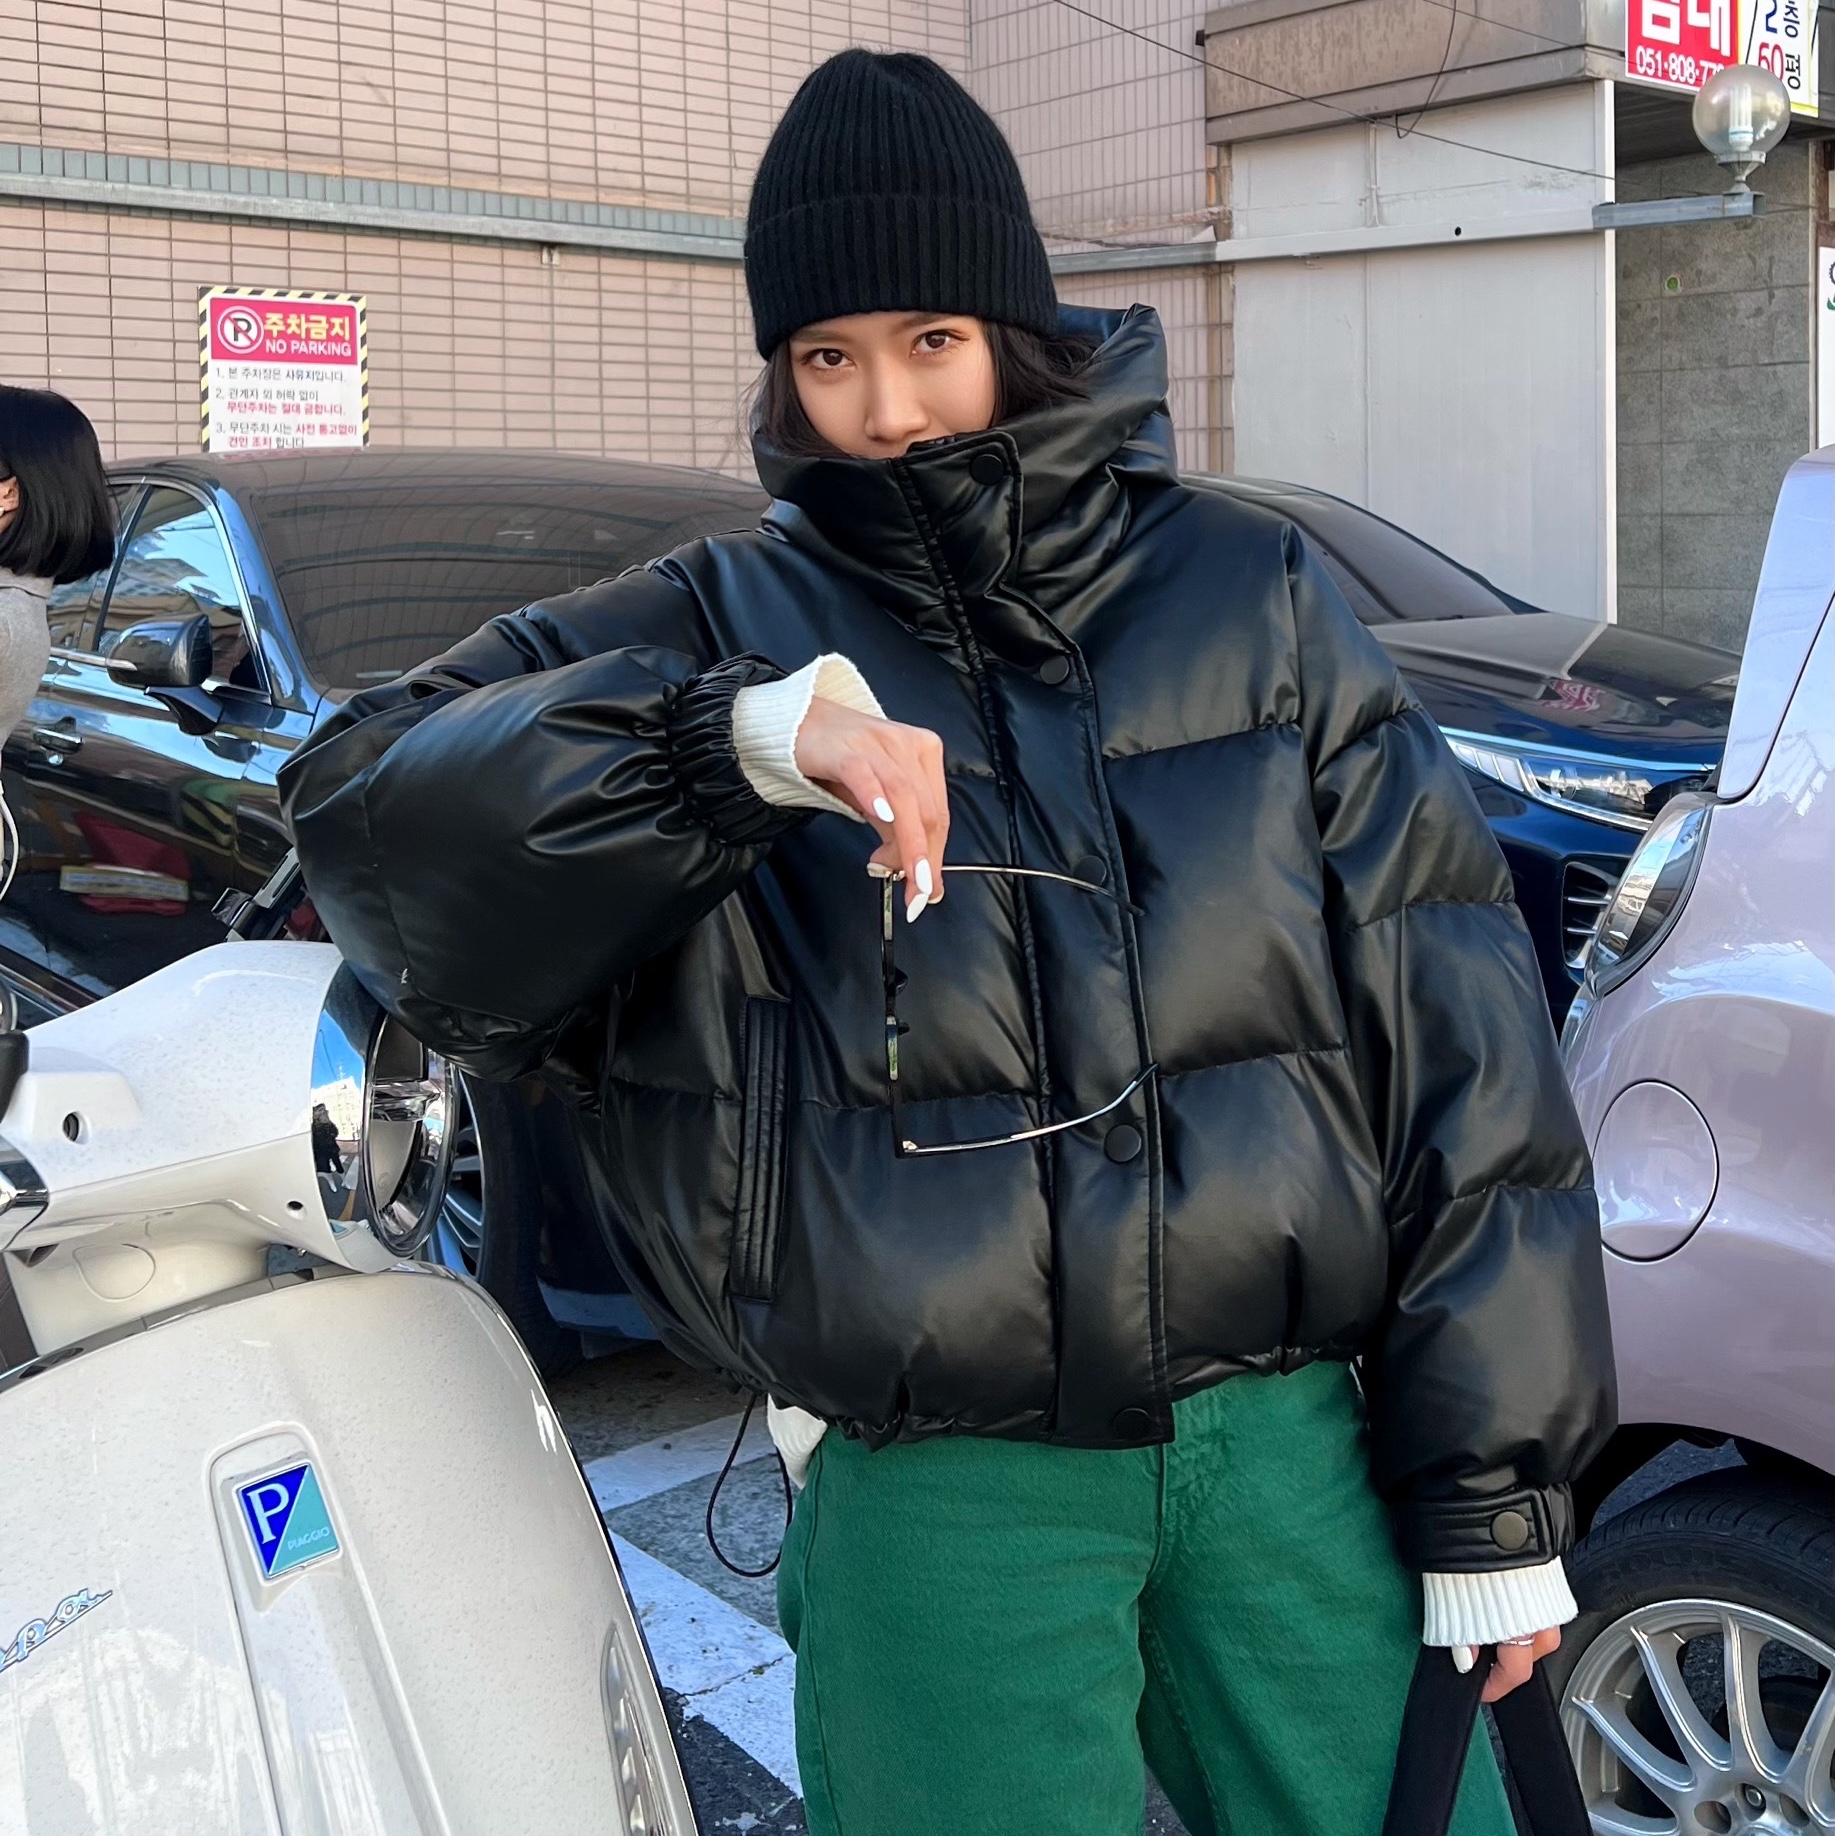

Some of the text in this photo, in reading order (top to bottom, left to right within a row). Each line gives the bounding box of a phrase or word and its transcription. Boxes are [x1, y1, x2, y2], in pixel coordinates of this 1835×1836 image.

[263, 312, 350, 341] 주차금지
[265, 340, 352, 357] NO PARKING
[228, 367, 238, 379] 본
[241, 367, 281, 381] 주차장은
[229, 388, 259, 400] 관계자
[263, 389, 273, 400] 외
[276, 389, 295, 400] 허락
[299, 390, 319, 401] 없이
[227, 401, 346, 416] 무단주차는 절대 금합니다.
[229, 421, 270, 435] 무단주차
[273, 422, 292, 435] 시는
[296, 422, 315, 435] 사전
[251, 437, 272, 449] 조치
[246, 1482, 290, 1545] P
[287, 1526, 331, 1551] PIAGGIO
